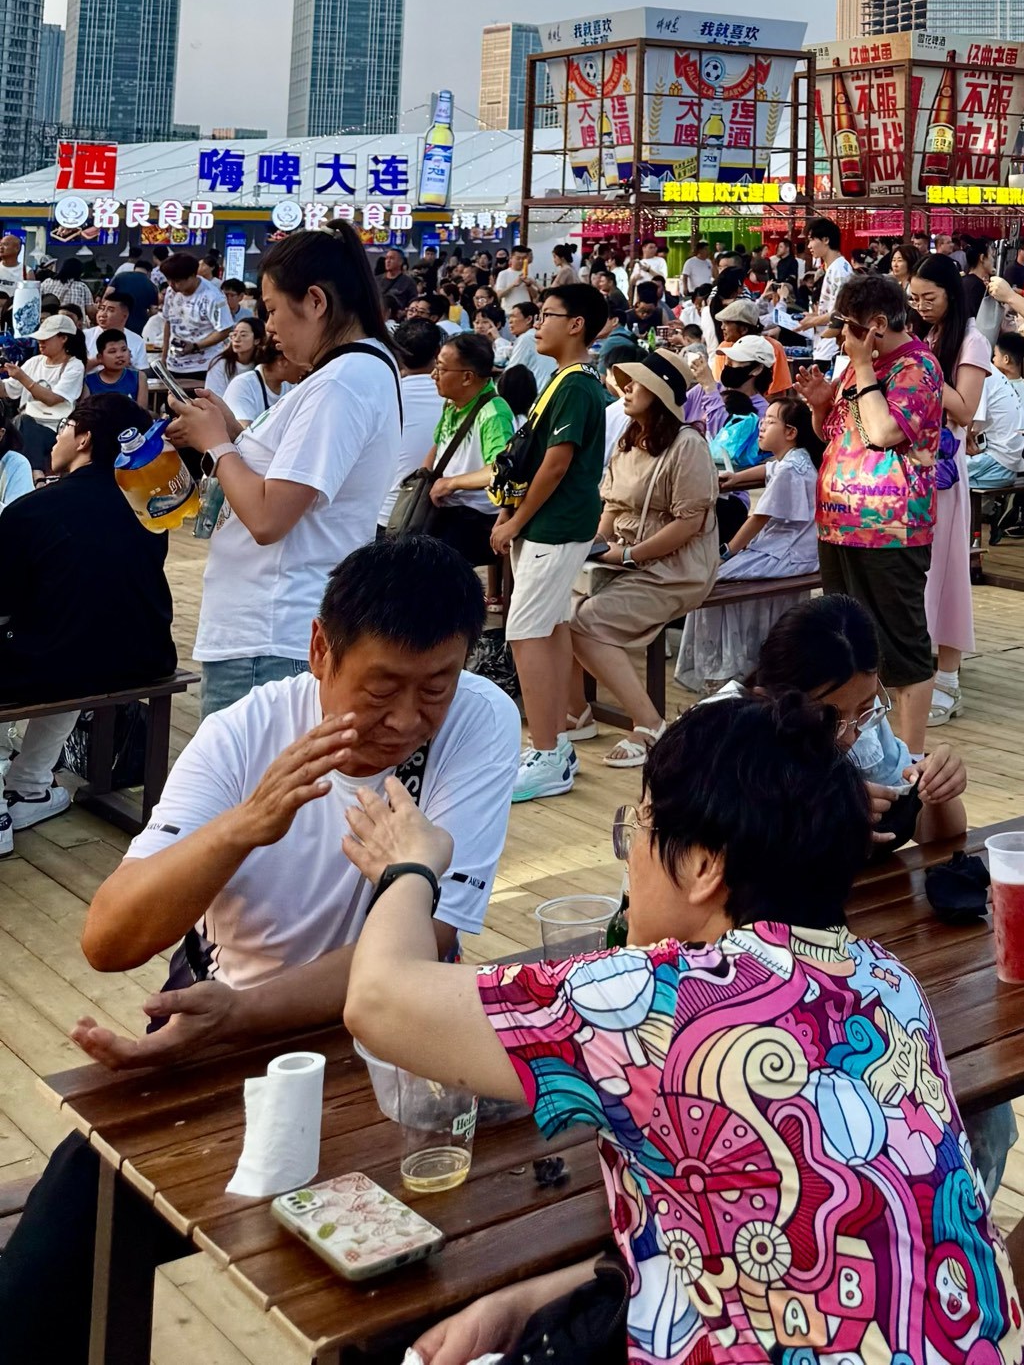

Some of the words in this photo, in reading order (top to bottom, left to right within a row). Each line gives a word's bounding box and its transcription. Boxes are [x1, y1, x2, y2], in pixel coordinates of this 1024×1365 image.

[573, 18, 612, 39] 我就喜欢
[700, 21, 760, 41] 我就喜欢
[855, 81, 899, 120] 不服
[961, 81, 1014, 121] 不服
[56, 141, 119, 190] 酒
[198, 148, 410, 197] 嗨啤大连
[92, 197, 215, 230] 铭良食品
[892, 1037, 914, 1080] KIDS
[782, 1295, 811, 1337] A
